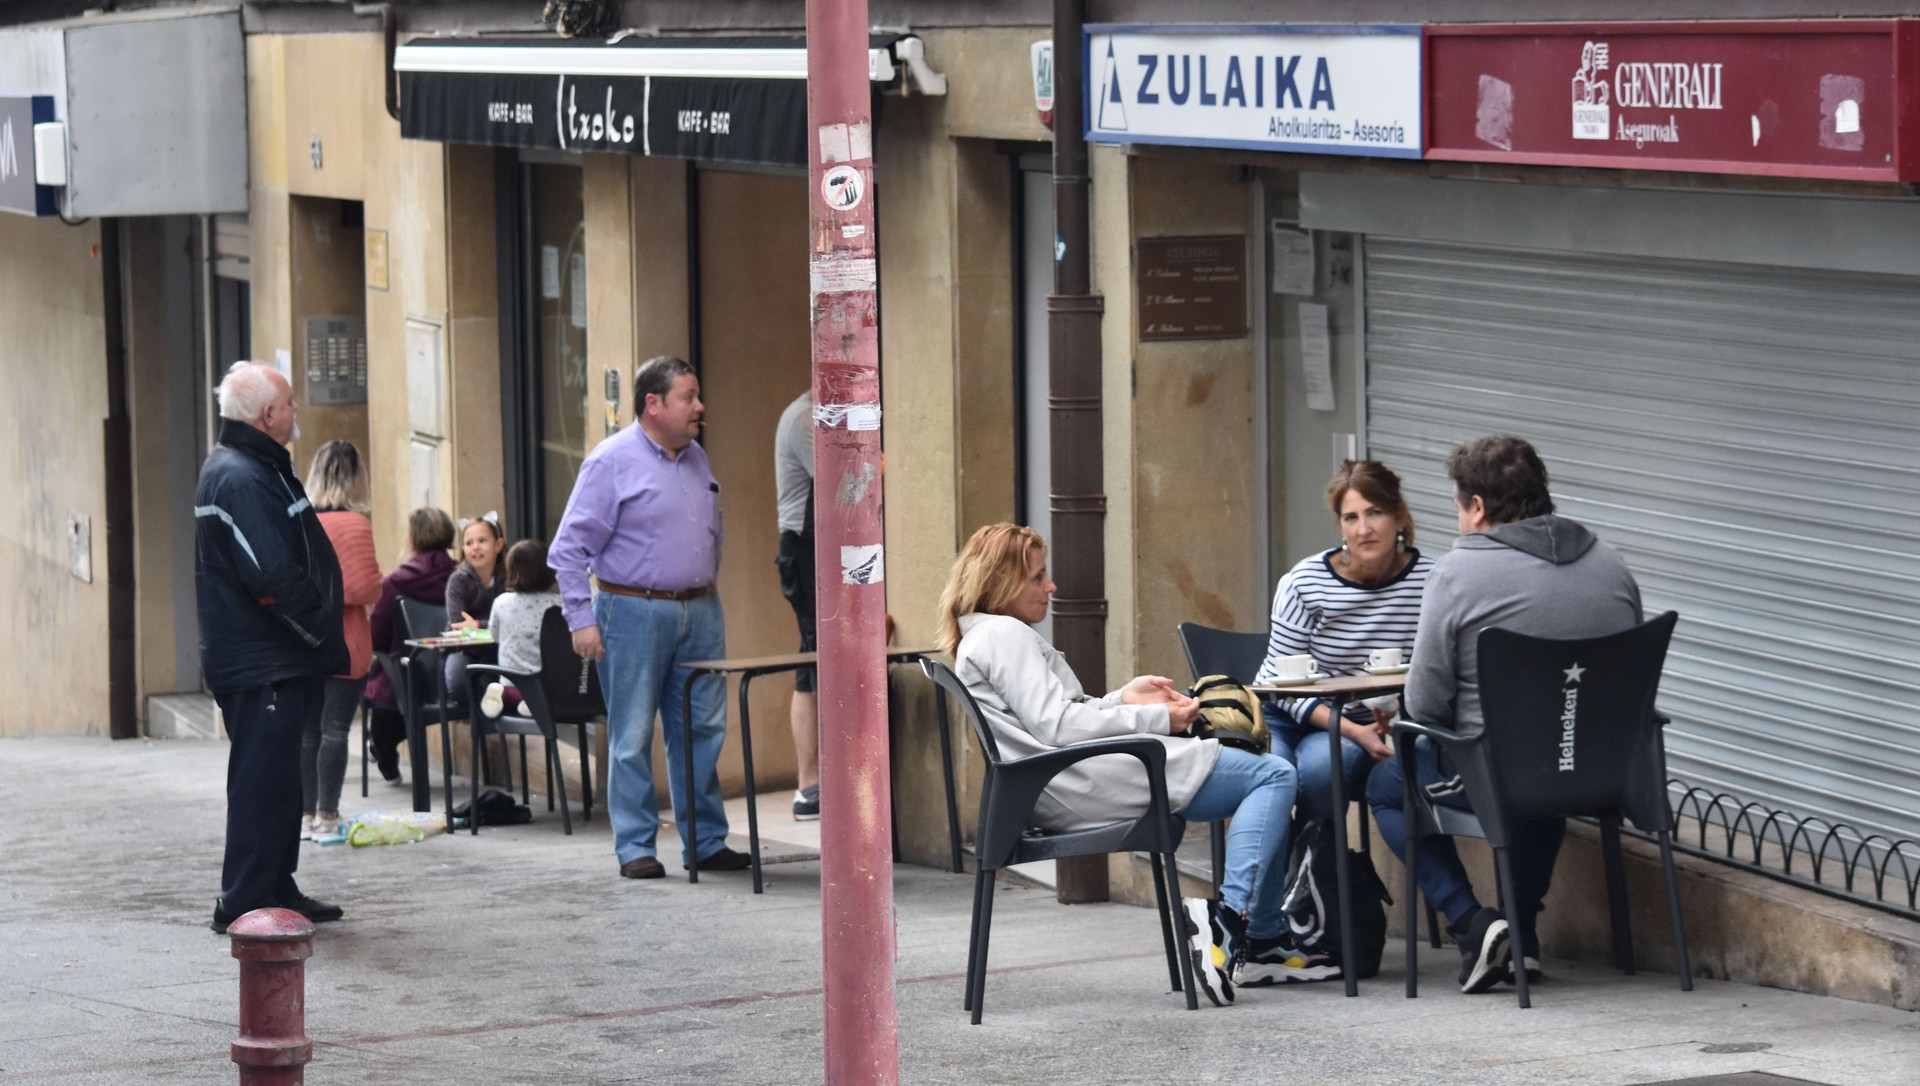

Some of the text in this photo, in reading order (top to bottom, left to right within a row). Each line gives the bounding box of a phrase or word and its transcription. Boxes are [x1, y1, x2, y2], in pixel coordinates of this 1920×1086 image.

[1137, 54, 1336, 111] ZULAIKA
[1615, 62, 1723, 110] GENERALI
[489, 102, 534, 125] KAFE BAR
[568, 84, 634, 144] txoko
[678, 110, 731, 135] KAFE BAR
[1269, 116, 1405, 144] Aholkularitza Asesoría
[1615, 113, 1680, 150] Aseguroak
[1559, 688, 1577, 772] Heineken
